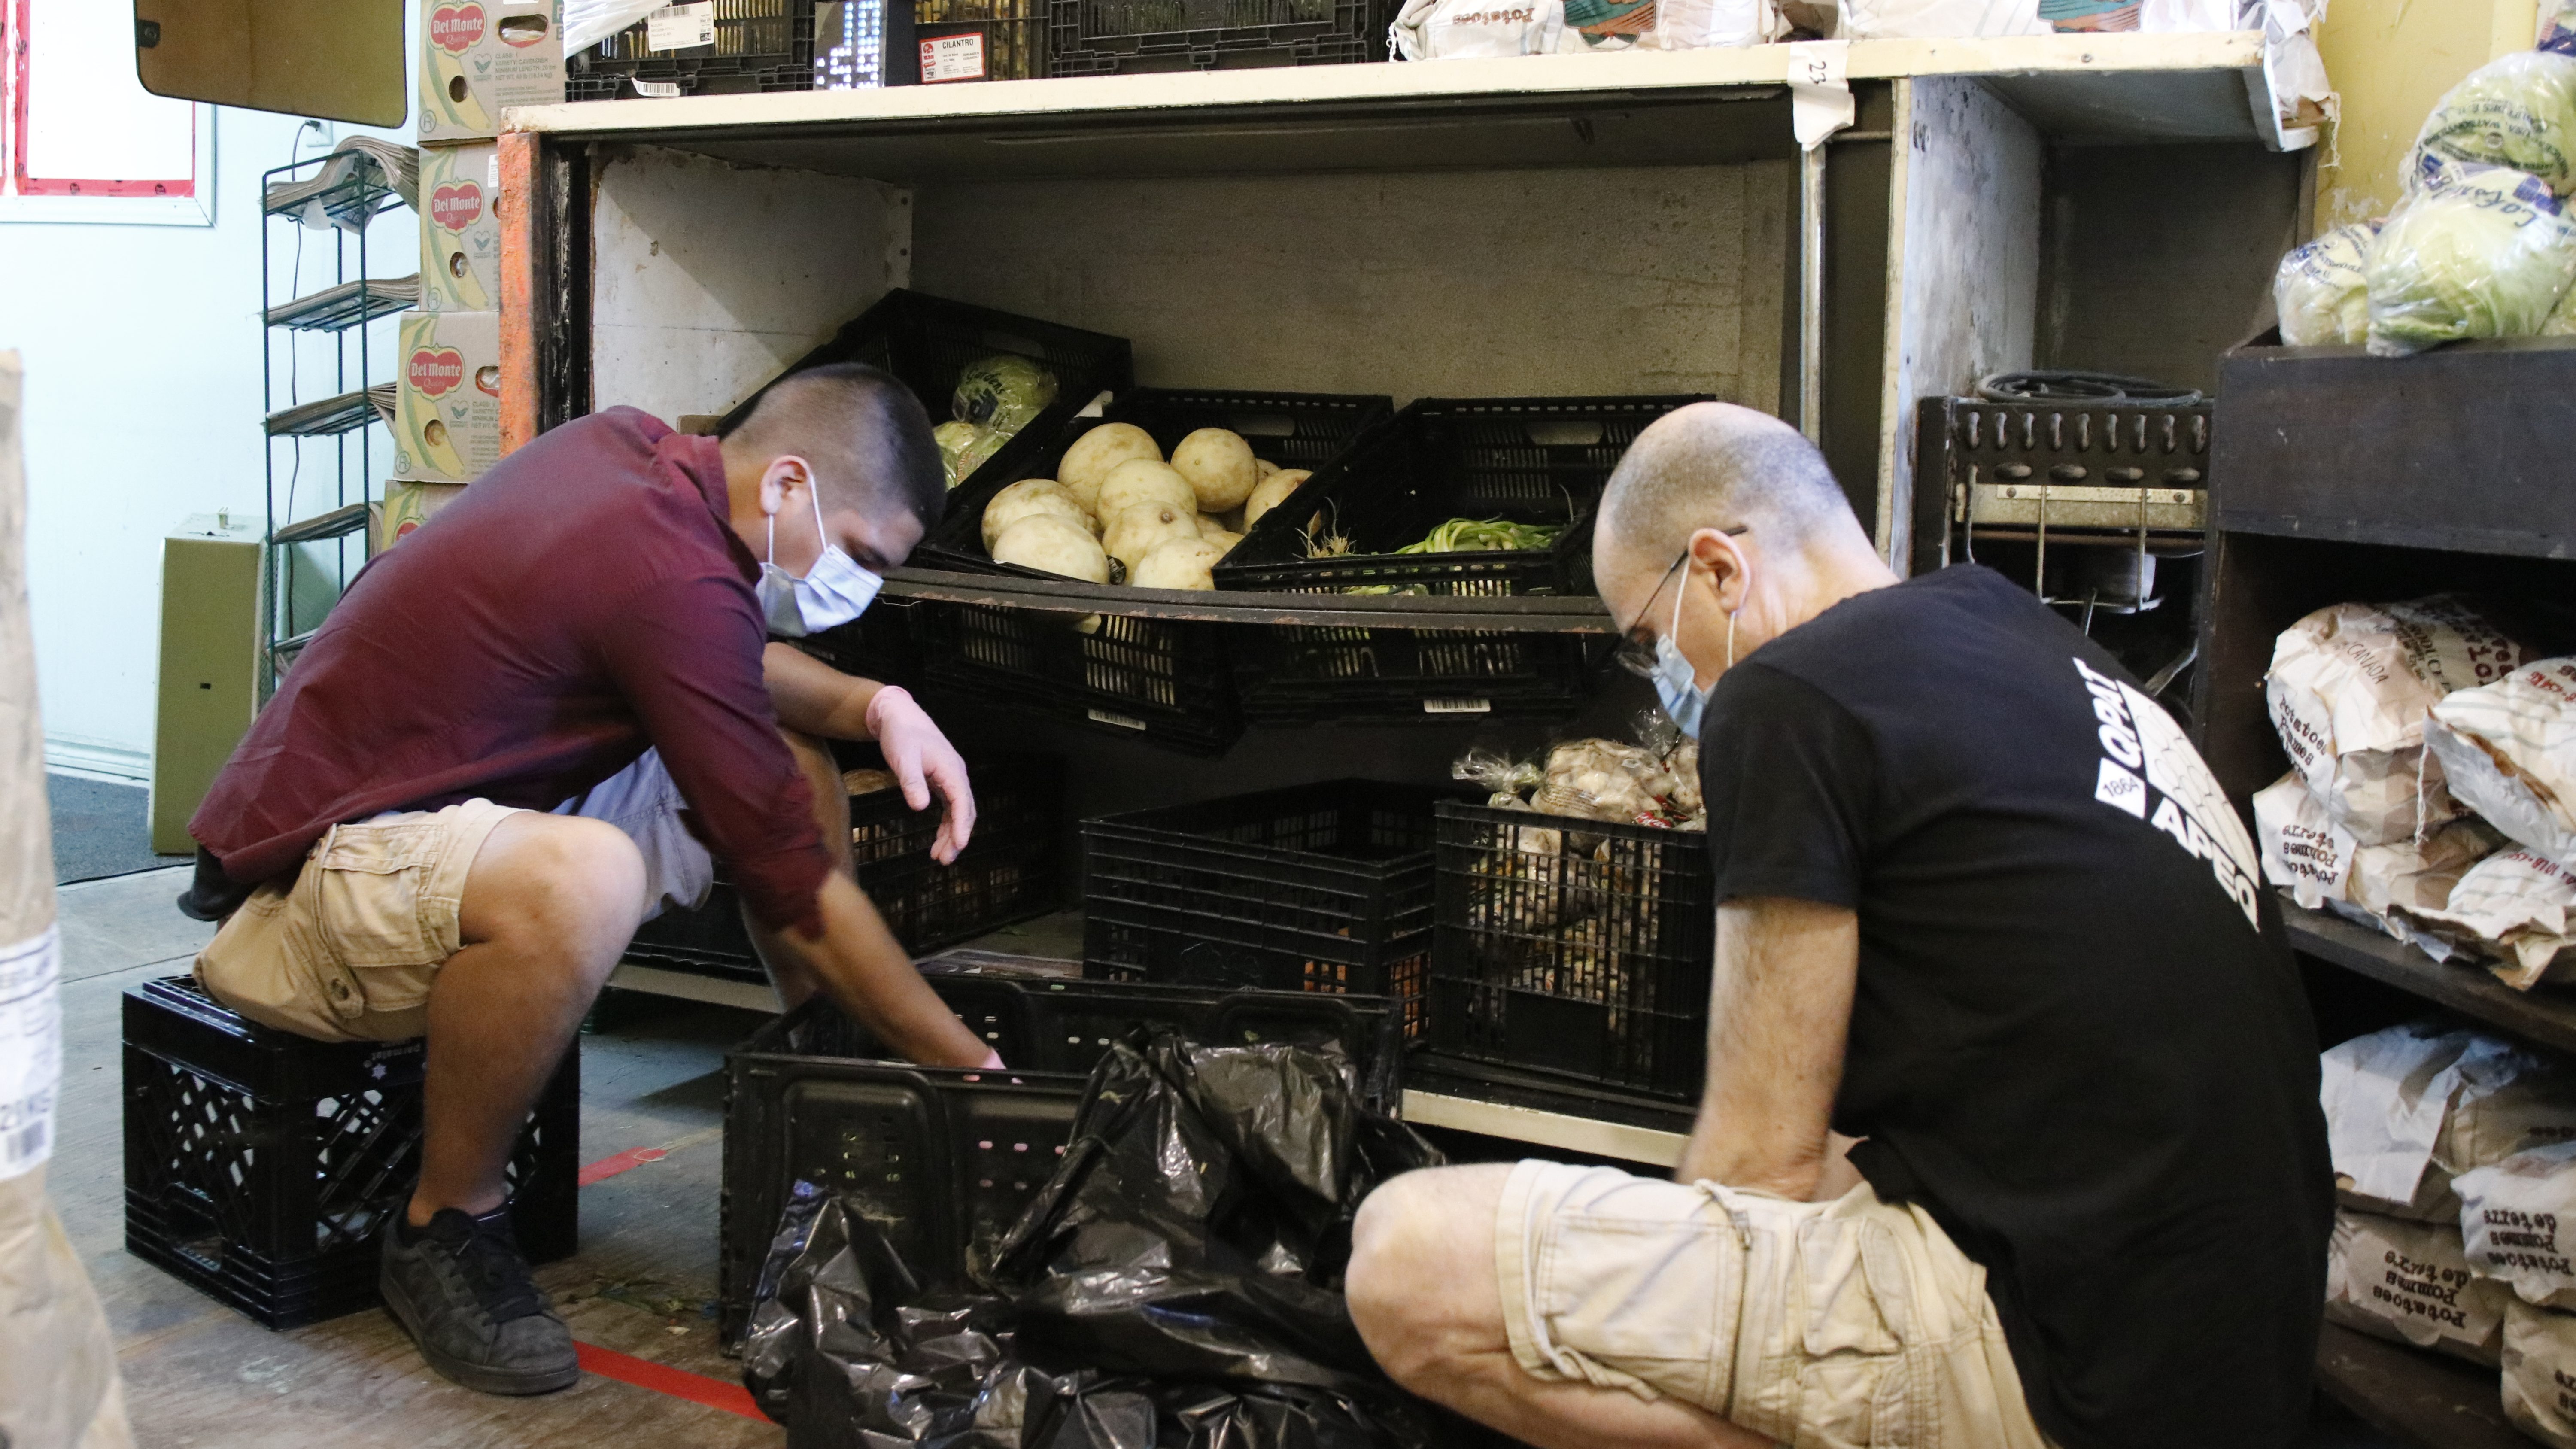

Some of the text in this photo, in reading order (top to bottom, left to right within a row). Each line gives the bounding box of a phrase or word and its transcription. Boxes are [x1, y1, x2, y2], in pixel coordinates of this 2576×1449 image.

[433, 18, 483, 34] Del Monte
[1452, 7, 1535, 25] Potatoes
[942, 39, 974, 49] CILANTRO
[1809, 61, 1826, 84] 23
[434, 197, 480, 213] Del Monte
[411, 363, 461, 377] Del Monte
[965, 368, 1005, 395] Gardens
[2347, 643, 2389, 685] CANADA
[2103, 776, 2139, 798] 1864
[2534, 1214, 2557, 1233] de
[2490, 1231, 2558, 1253] Pommes
[2386, 1271, 2459, 1307] Pommes
[2441, 1267, 2469, 1289] de
[2373, 1286, 2466, 1329] Potatoes
